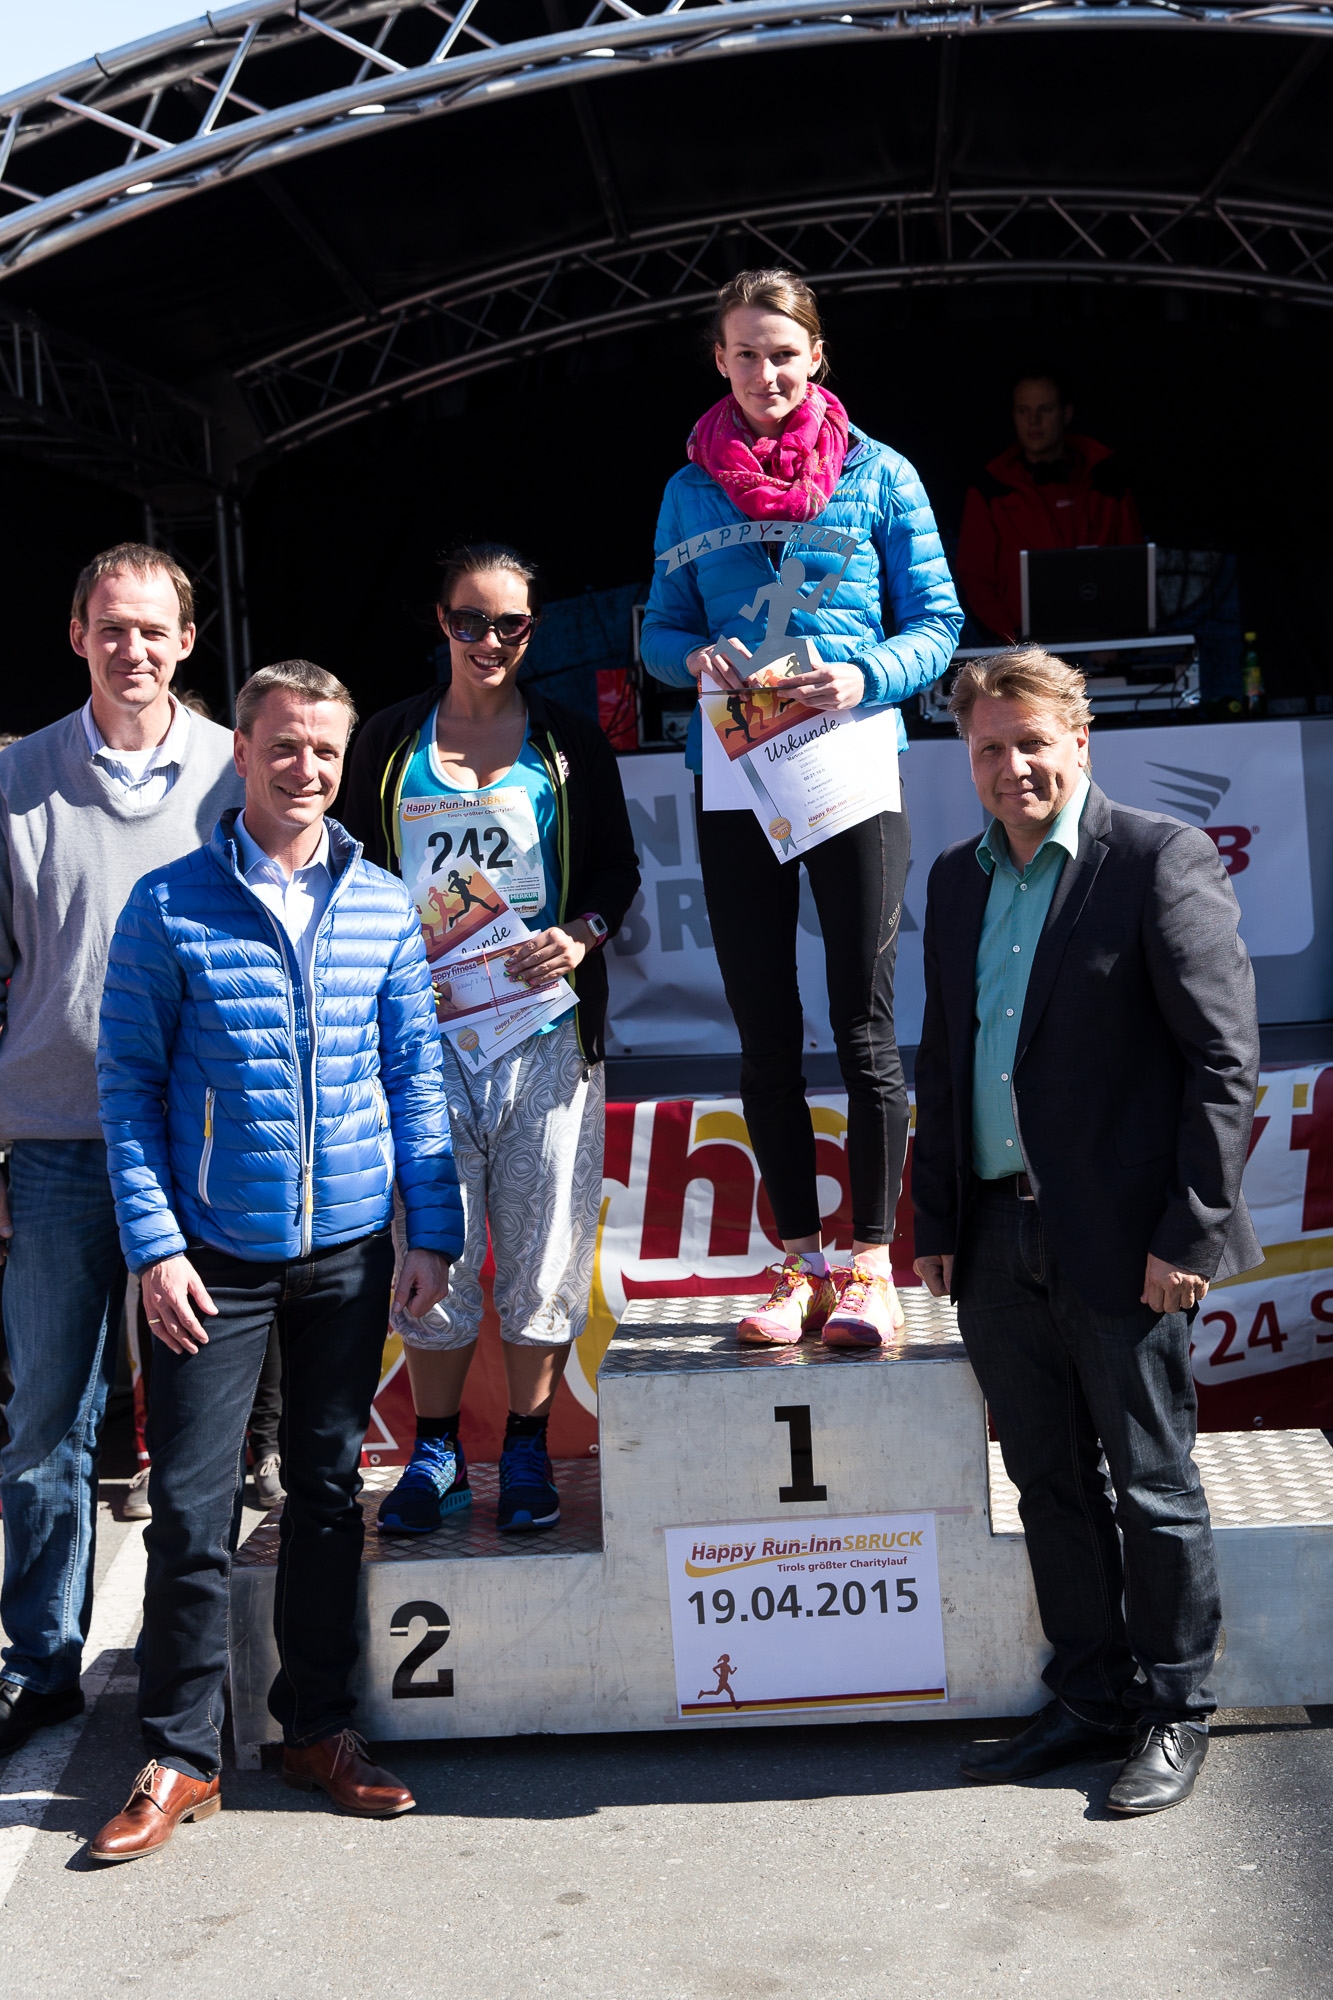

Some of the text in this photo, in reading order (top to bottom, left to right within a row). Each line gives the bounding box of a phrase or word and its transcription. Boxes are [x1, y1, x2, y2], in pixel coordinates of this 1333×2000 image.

[764, 717, 840, 762] Urkunde
[406, 801, 437, 813] Happy
[427, 826, 513, 876] 242
[432, 969, 451, 983] appy
[451, 961, 477, 976] fitness
[494, 1018, 510, 1031] Happy
[1202, 1301, 1289, 1367] 24
[774, 1404, 828, 1503] 1
[691, 1530, 924, 1563] Happy Run-InnSBRUCK
[777, 1556, 908, 1574] Tirols größter Charitylauf
[687, 1577, 919, 1625] 19.04.2015
[390, 1600, 454, 1699] 2
